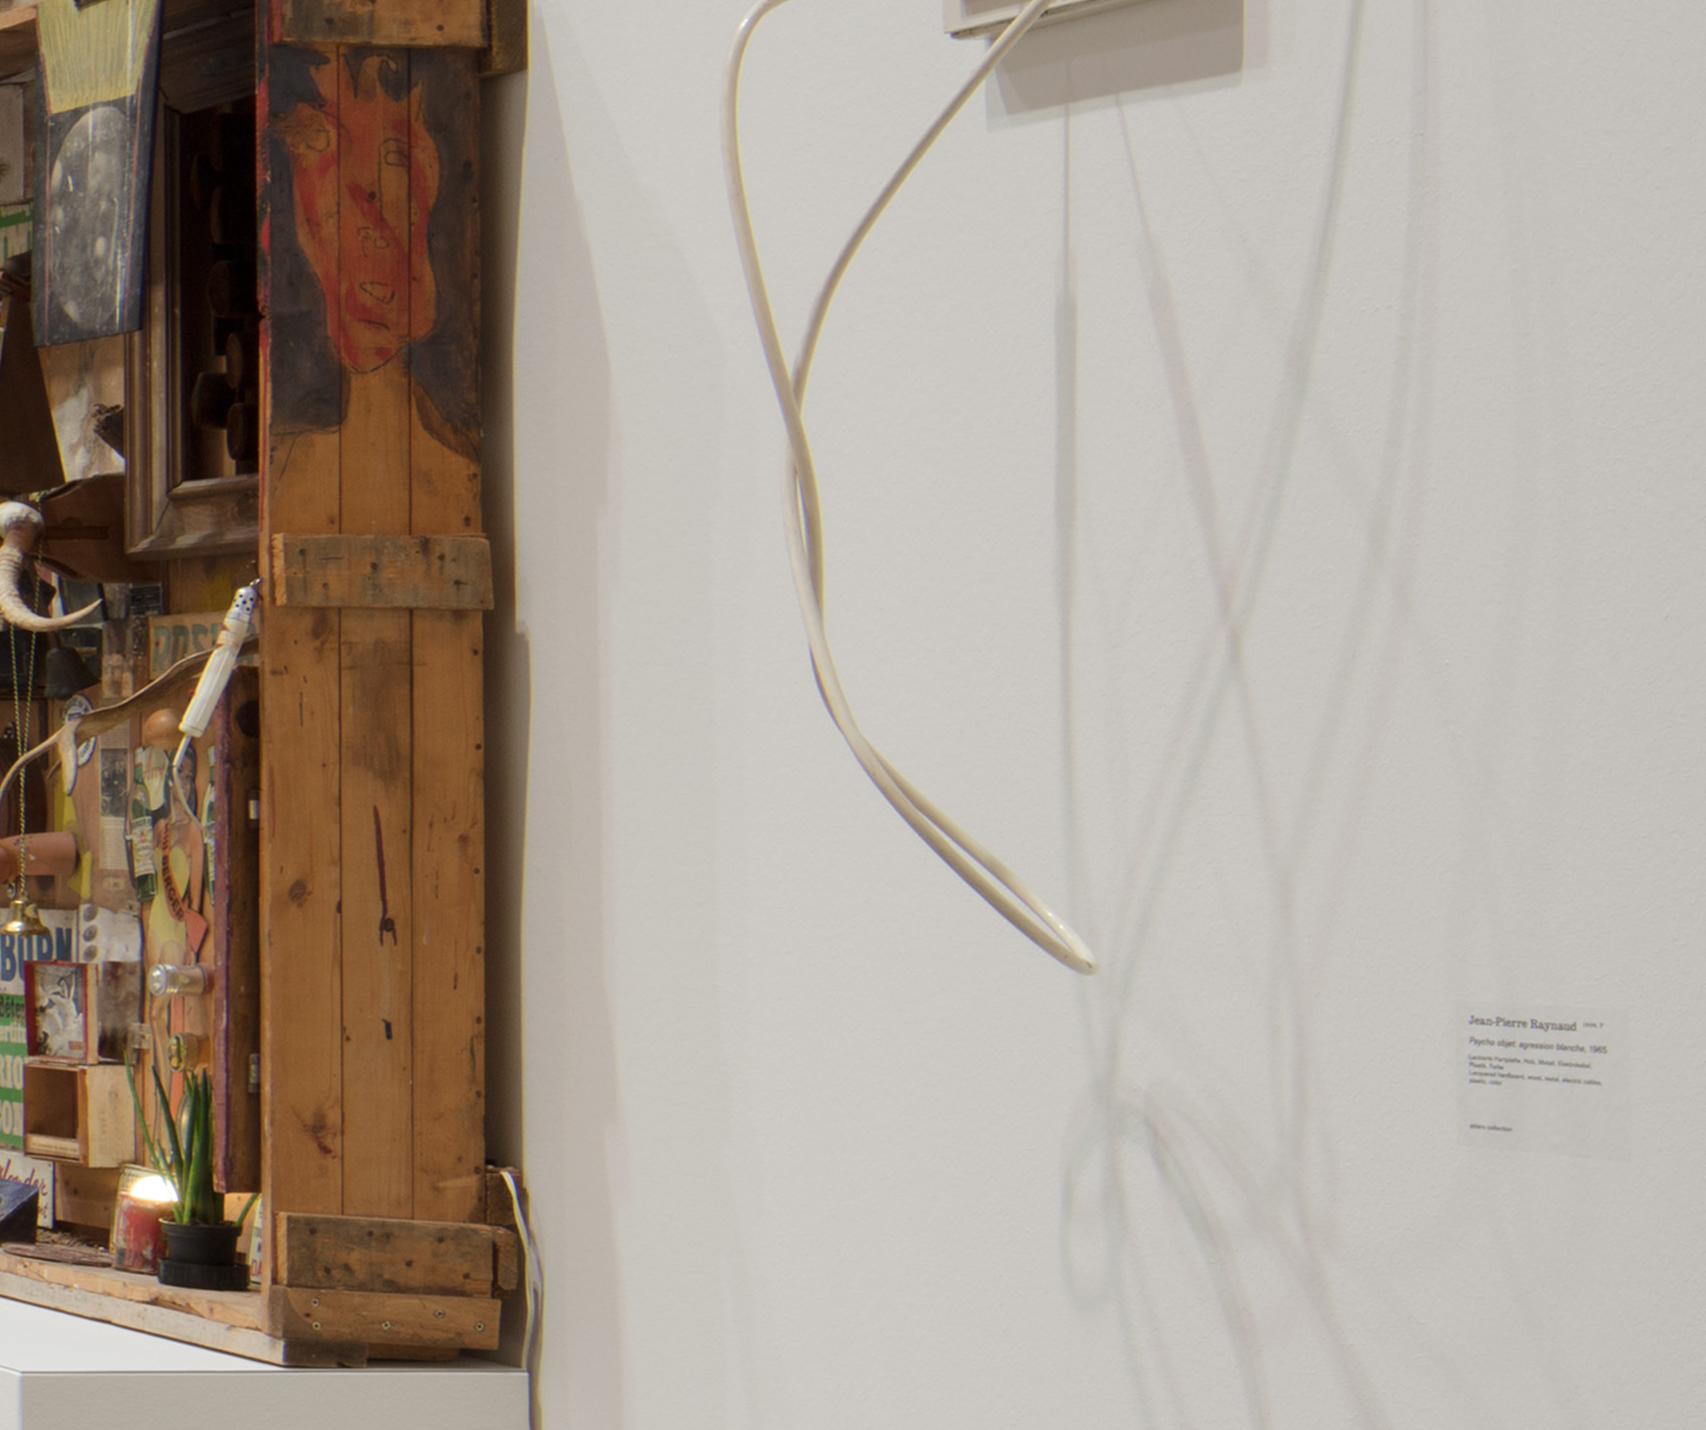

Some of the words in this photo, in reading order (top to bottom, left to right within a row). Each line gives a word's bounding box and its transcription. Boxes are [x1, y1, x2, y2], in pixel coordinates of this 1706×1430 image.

[1468, 1015, 1528, 1029] Jean-Pierre
[1530, 1018, 1578, 1032] Raynaud
[1469, 1036, 1495, 1047] Psycho
[1589, 1045, 1608, 1054] 1965
